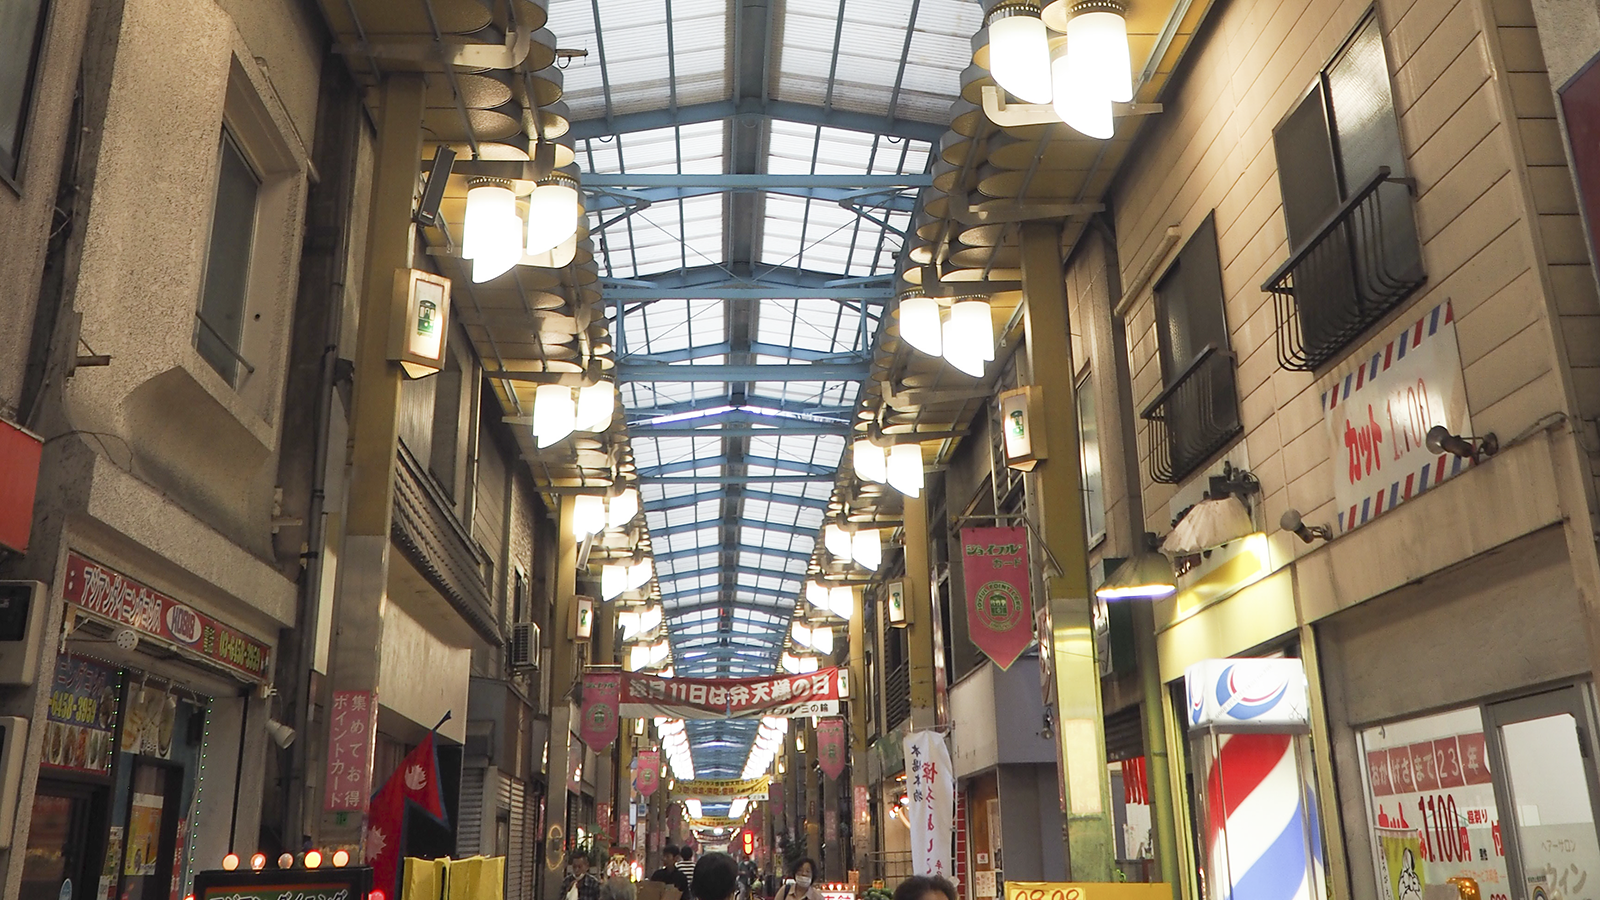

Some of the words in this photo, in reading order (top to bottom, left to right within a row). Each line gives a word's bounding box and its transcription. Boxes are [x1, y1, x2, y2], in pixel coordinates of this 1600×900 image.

[1344, 403, 1382, 486] カット
[966, 544, 1023, 557] ジョイフル
[992, 558, 1022, 569] カード
[629, 673, 830, 707] 毎月11日は弁天様の日
[330, 694, 350, 808] ポイントカード
[344, 694, 367, 808] 集めてお得
[1371, 743, 1481, 788] おかげさまで23年
